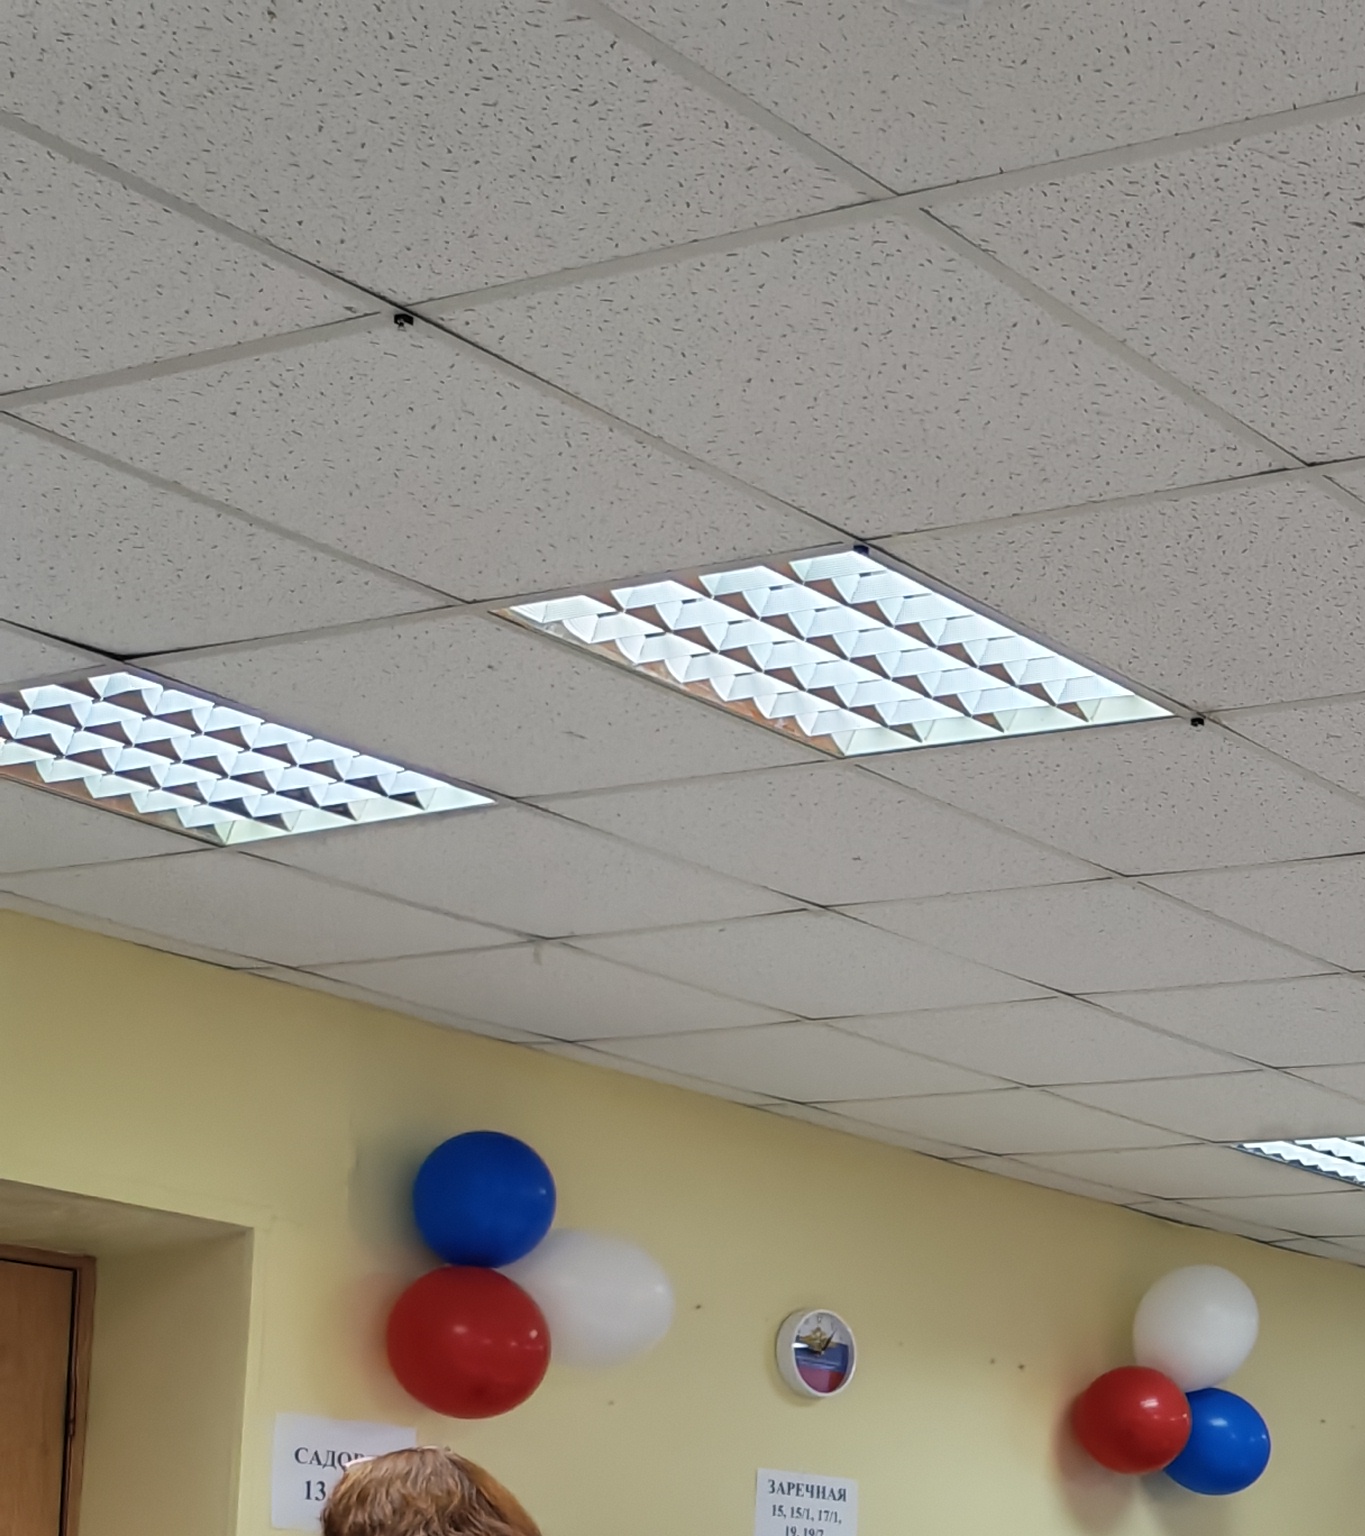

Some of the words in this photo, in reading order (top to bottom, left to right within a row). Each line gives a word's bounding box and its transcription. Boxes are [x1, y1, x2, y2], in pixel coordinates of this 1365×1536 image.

[767, 1479, 847, 1502] ЗАРЕЧНАЯ
[771, 1504, 787, 1519] 15,
[790, 1507, 814, 1522] 15/1,
[818, 1510, 842, 1525] 17/1,
